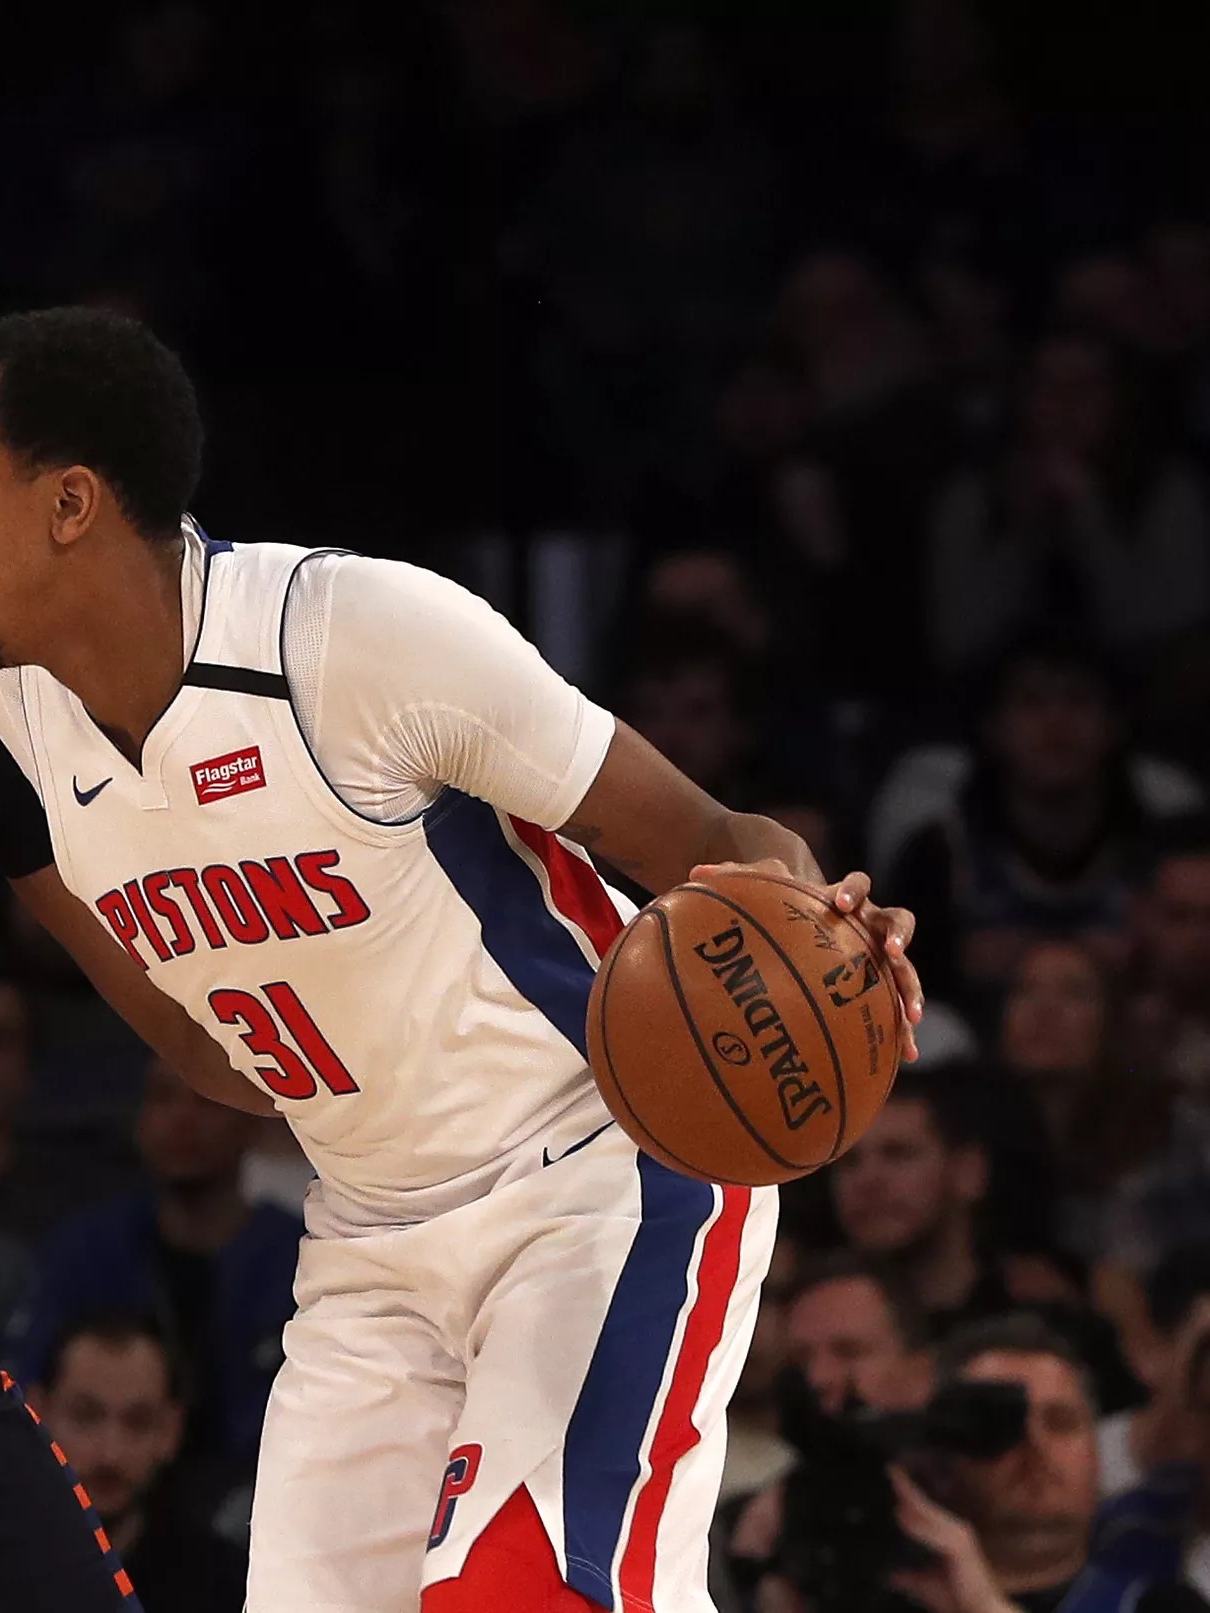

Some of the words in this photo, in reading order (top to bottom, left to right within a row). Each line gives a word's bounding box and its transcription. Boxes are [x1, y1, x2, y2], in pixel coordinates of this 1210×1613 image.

[194, 756, 258, 786] Flagstar
[95, 849, 371, 971] PISTONS
[207, 981, 361, 1100] 31
[693, 924, 832, 1131] SPALDING
